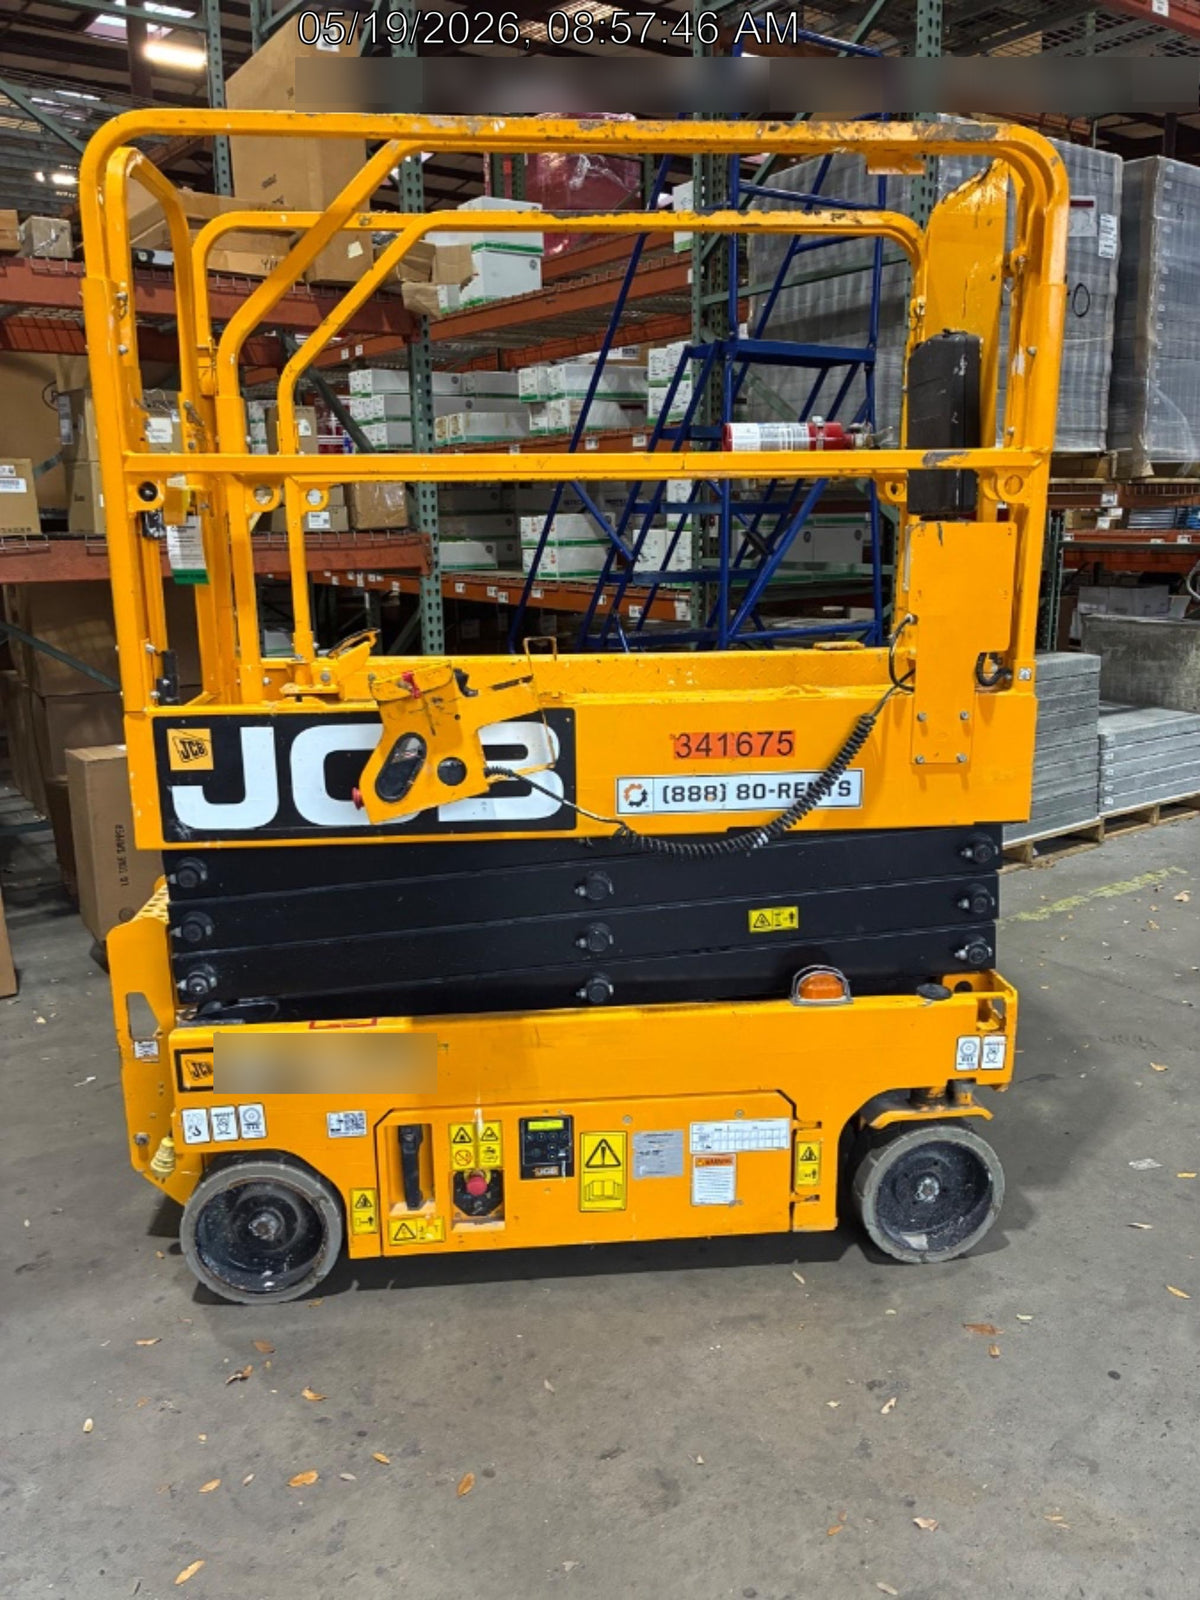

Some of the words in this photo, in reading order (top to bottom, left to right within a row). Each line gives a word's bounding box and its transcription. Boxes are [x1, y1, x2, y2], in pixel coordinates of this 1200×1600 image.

[180, 739, 206, 760] JCB
[675, 731, 794, 758] 341675
[166, 722, 565, 830] JCB
[662, 783, 727, 804] (888)
[737, 781, 852, 800] 80-RES
